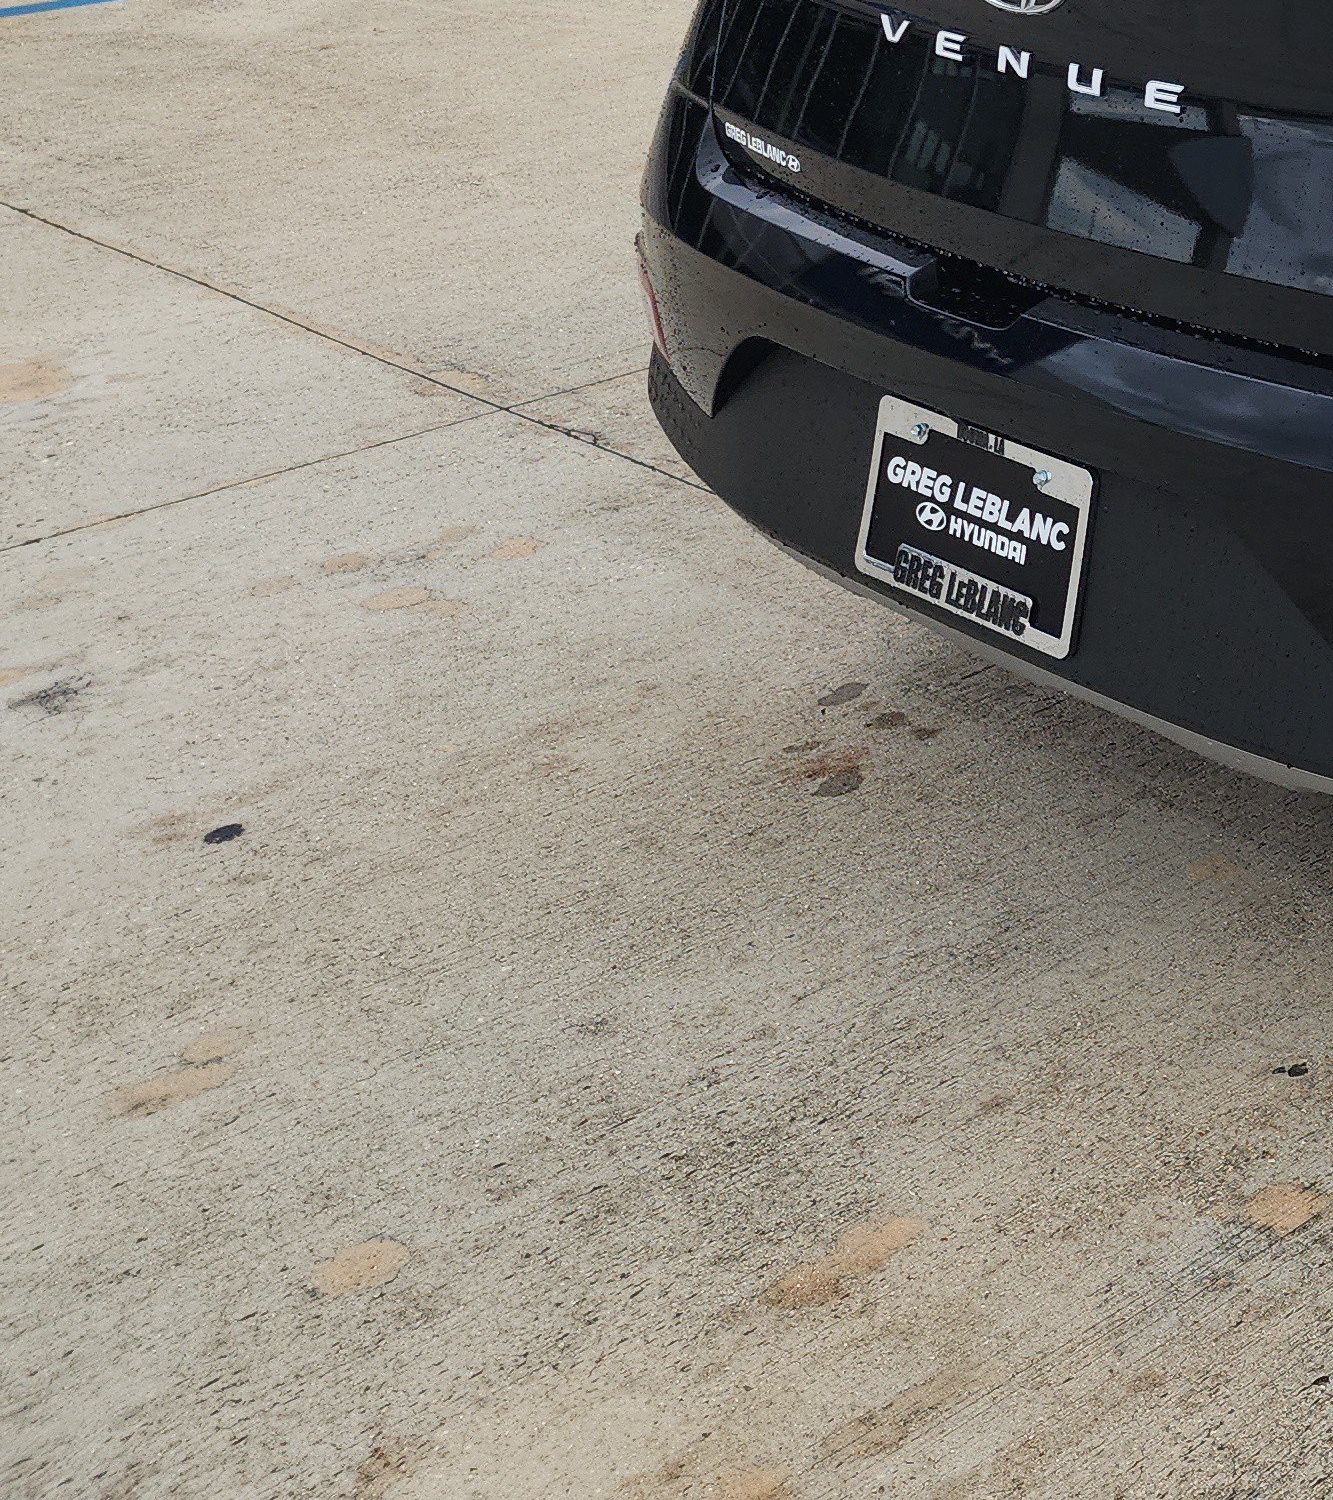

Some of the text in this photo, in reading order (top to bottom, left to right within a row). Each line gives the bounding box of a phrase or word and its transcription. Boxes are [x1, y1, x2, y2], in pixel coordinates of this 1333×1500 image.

[880, 12, 1186, 114] VENUE
[724, 121, 747, 146] GREG
[886, 456, 1070, 551] GREG LEBLANC
[949, 514, 1028, 566] HYUNDAI
[893, 548, 945, 600] GREG
